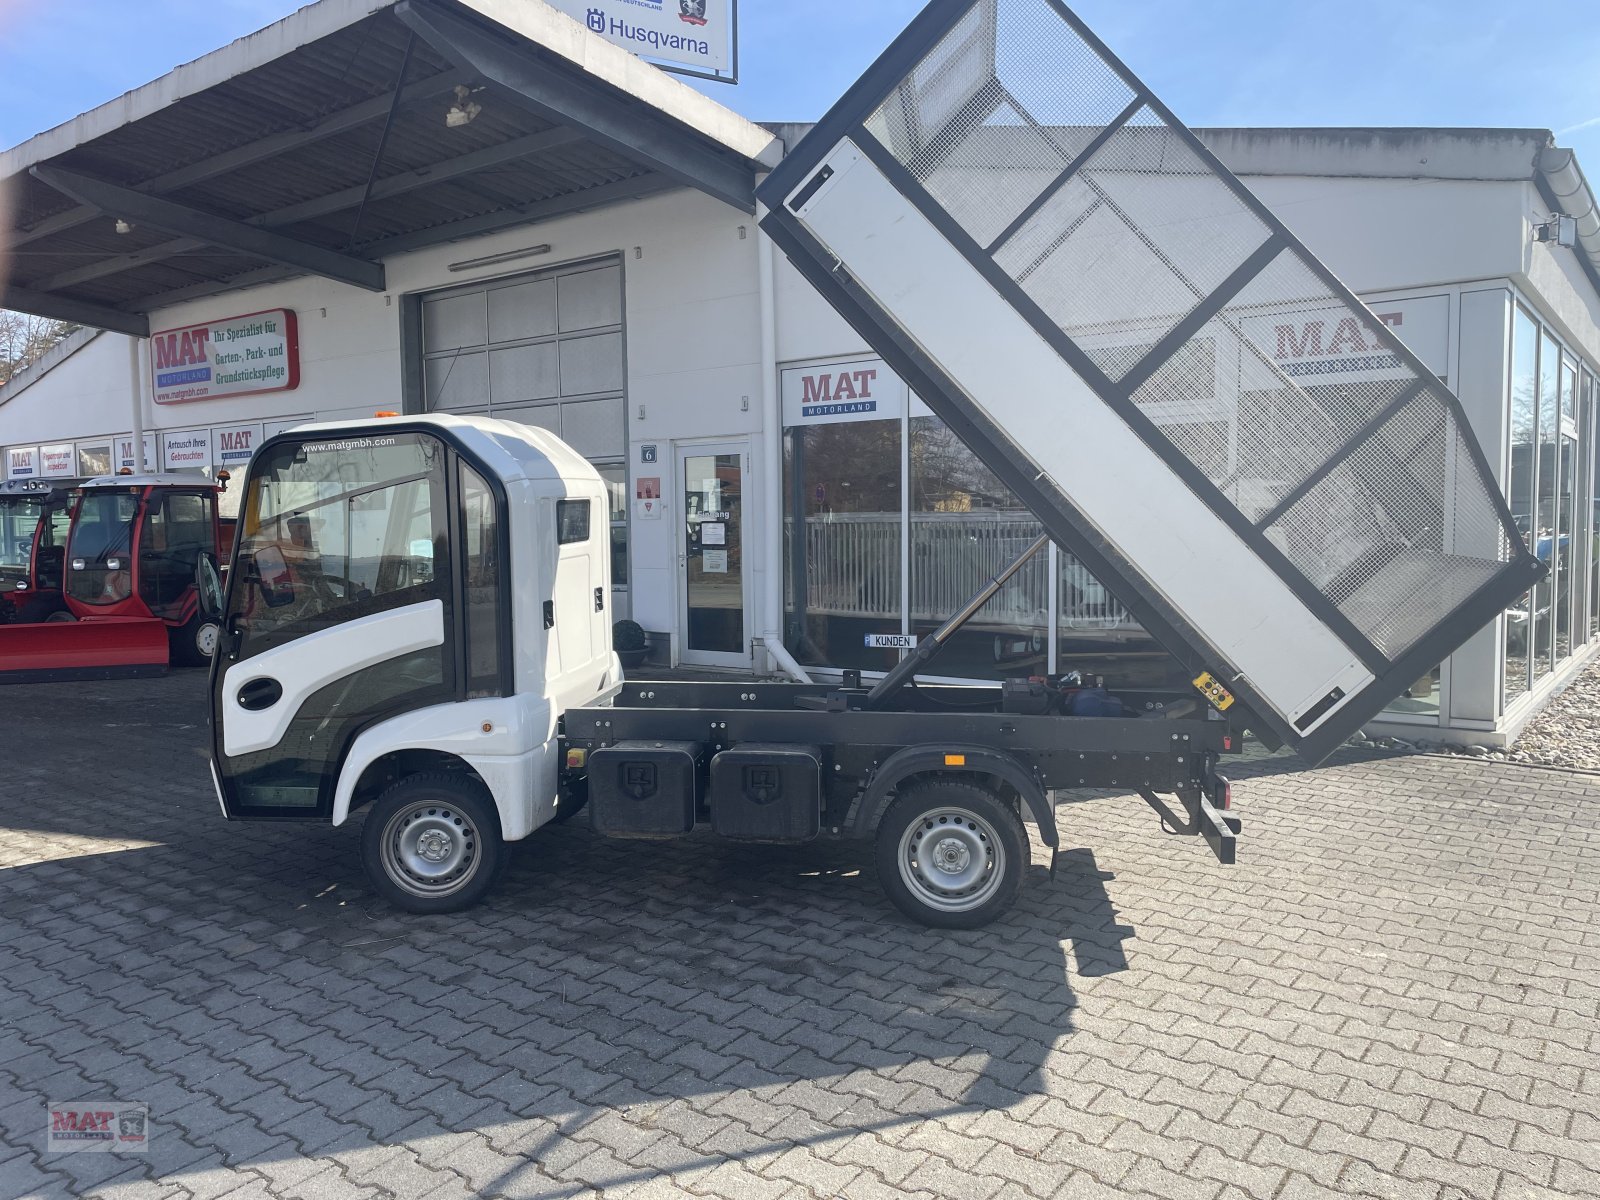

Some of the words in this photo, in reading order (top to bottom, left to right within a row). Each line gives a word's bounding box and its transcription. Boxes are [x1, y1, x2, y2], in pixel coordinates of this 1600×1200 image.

[610, 17, 709, 55] Husqvarna
[214, 330, 225, 342] Ihr
[226, 323, 263, 342] Spezialist
[265, 320, 276, 334] für
[155, 328, 209, 369] MAT
[246, 346, 267, 360] Park-
[268, 343, 283, 357] und
[216, 365, 285, 384] Grundstückspflege
[802, 370, 876, 402] MAT
[808, 403, 871, 415] MOTORLAND
[221, 431, 251, 450] MAT
[302, 437, 395, 452] www.matgmbh.com
[12, 452, 32, 467] MAT
[646, 450, 652, 461] 6
[875, 636, 910, 647] KUNDEN
